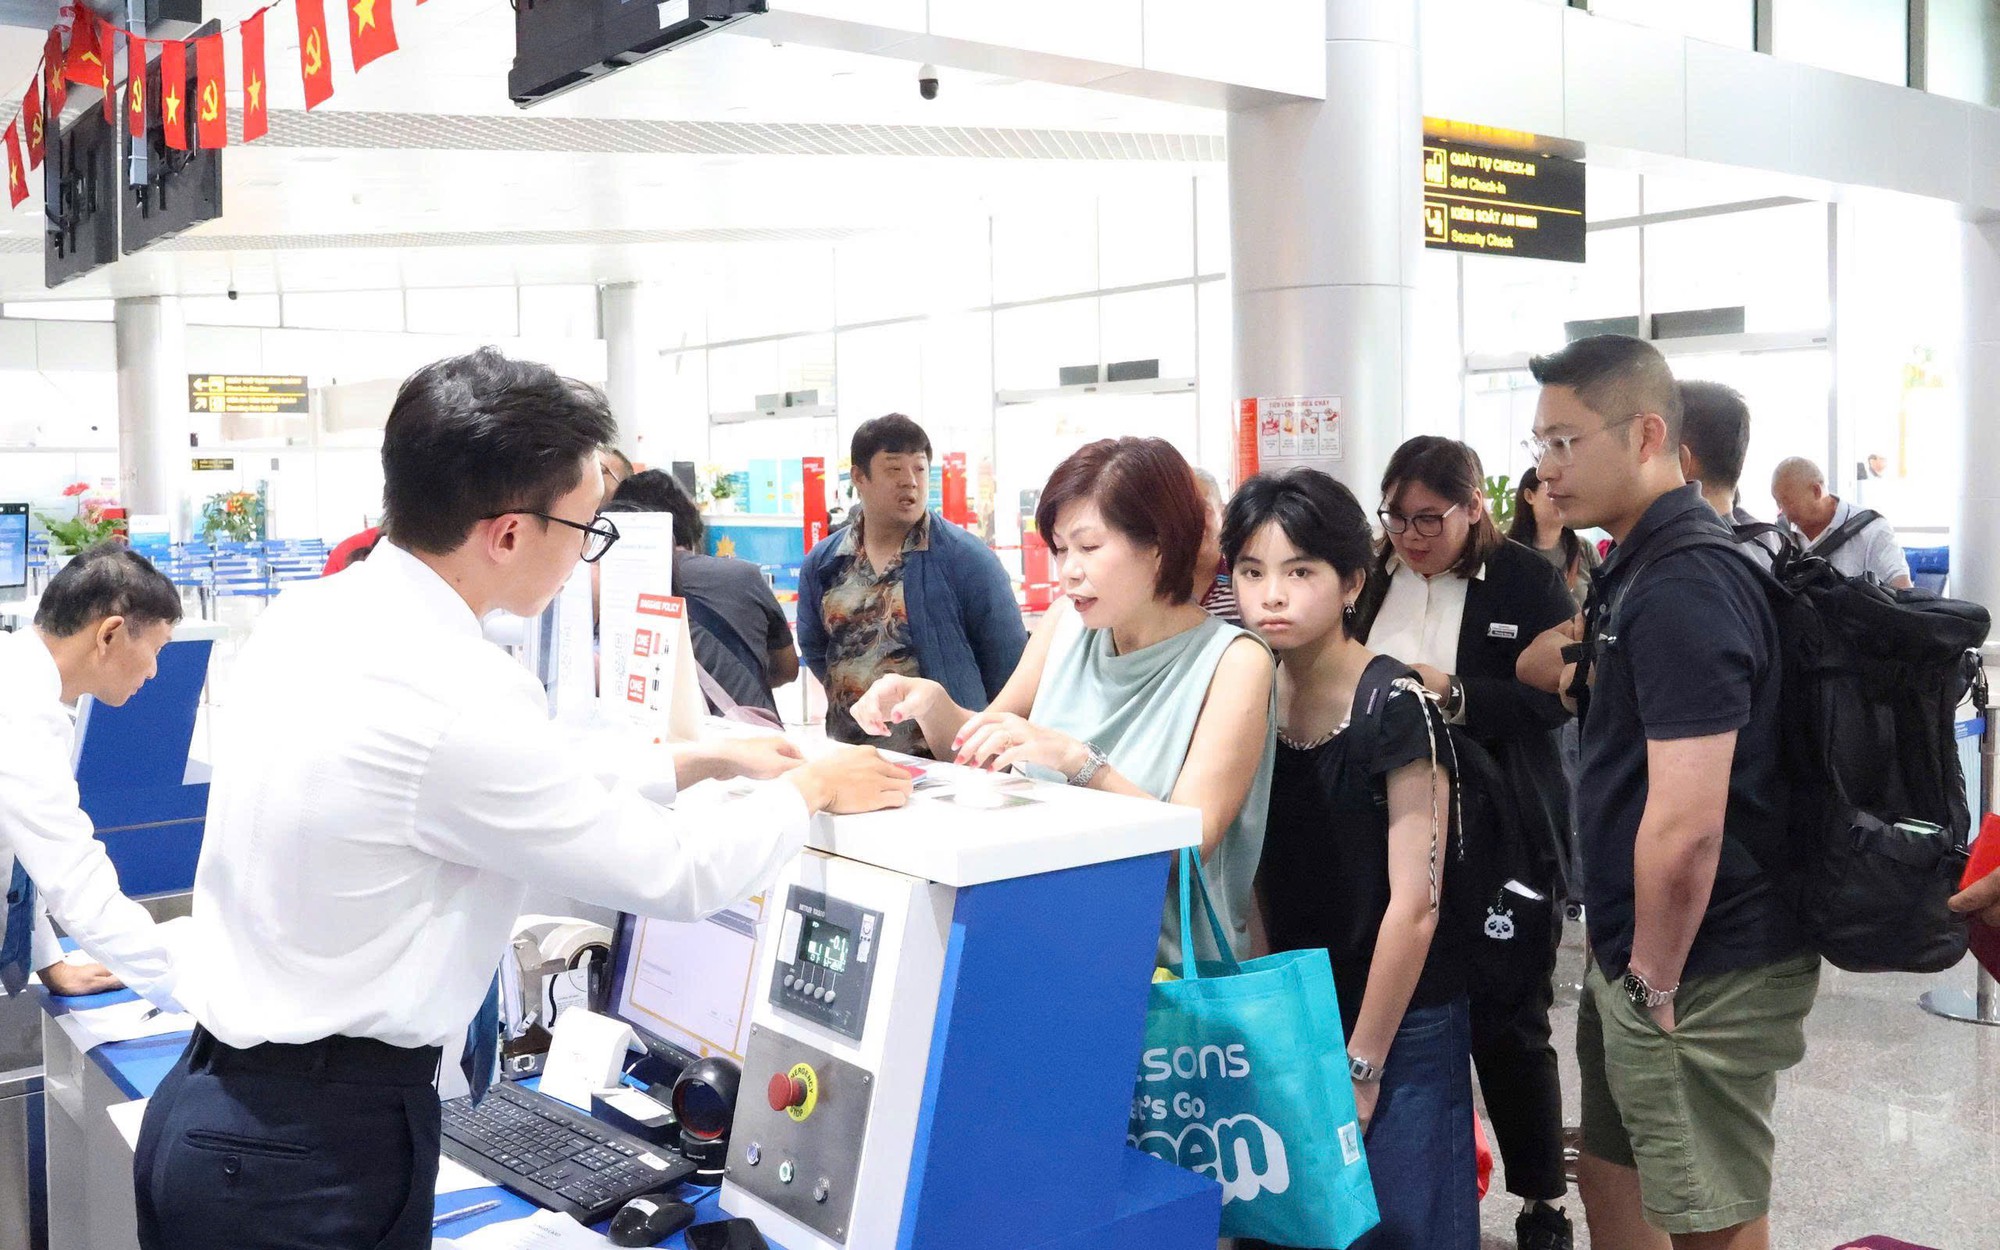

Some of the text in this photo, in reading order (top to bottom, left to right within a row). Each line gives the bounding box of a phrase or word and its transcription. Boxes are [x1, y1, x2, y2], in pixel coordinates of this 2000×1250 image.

[1137, 1044, 1250, 1082] sons
[790, 1067, 814, 1094] MERGENCY
[1173, 1091, 1206, 1119] Go
